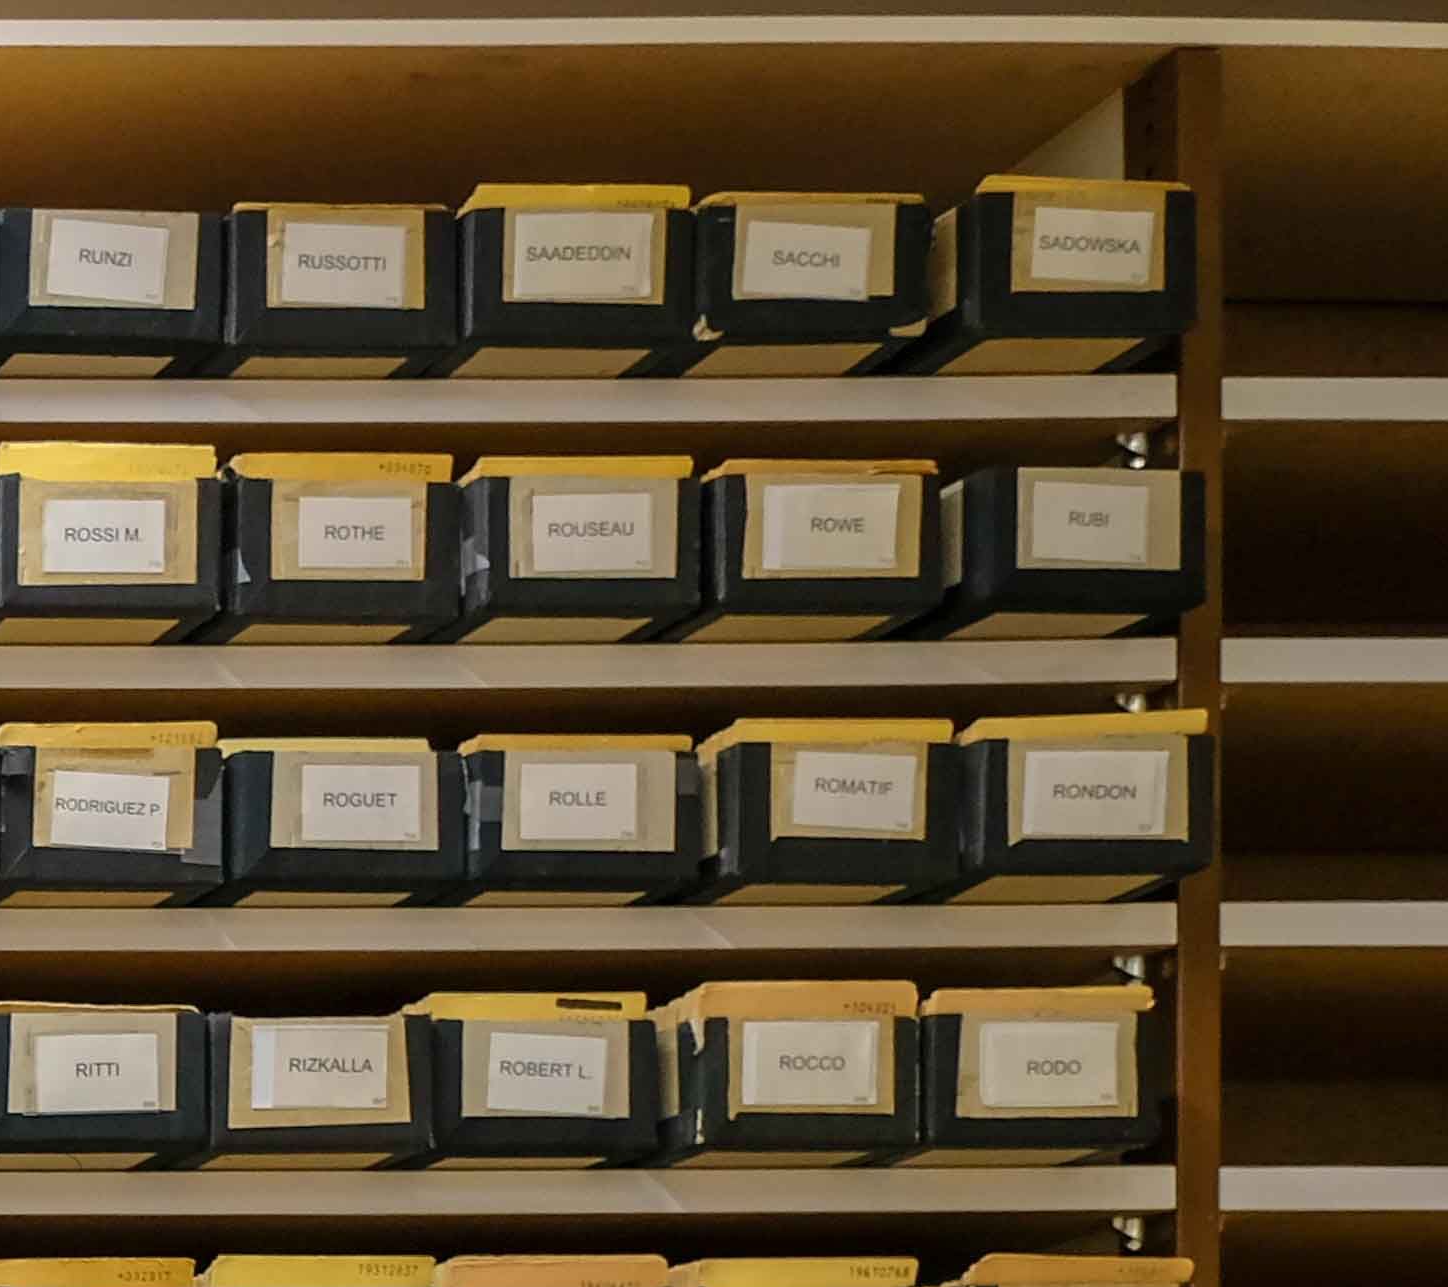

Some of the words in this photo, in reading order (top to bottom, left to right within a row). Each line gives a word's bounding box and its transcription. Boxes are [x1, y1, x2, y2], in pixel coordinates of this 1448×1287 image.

[525, 245, 632, 263] SAADEDDIN
[771, 249, 841, 268] SACCHI
[323, 524, 385, 542] ROTHE
[810, 516, 865, 534] ROWE
[322, 791, 398, 809] ROGUET
[548, 790, 607, 808] ROLLE
[1052, 783, 1138, 801] RONDON
[288, 1057, 374, 1073] RIZKALLA
[1026, 1059, 1083, 1077] RODO
